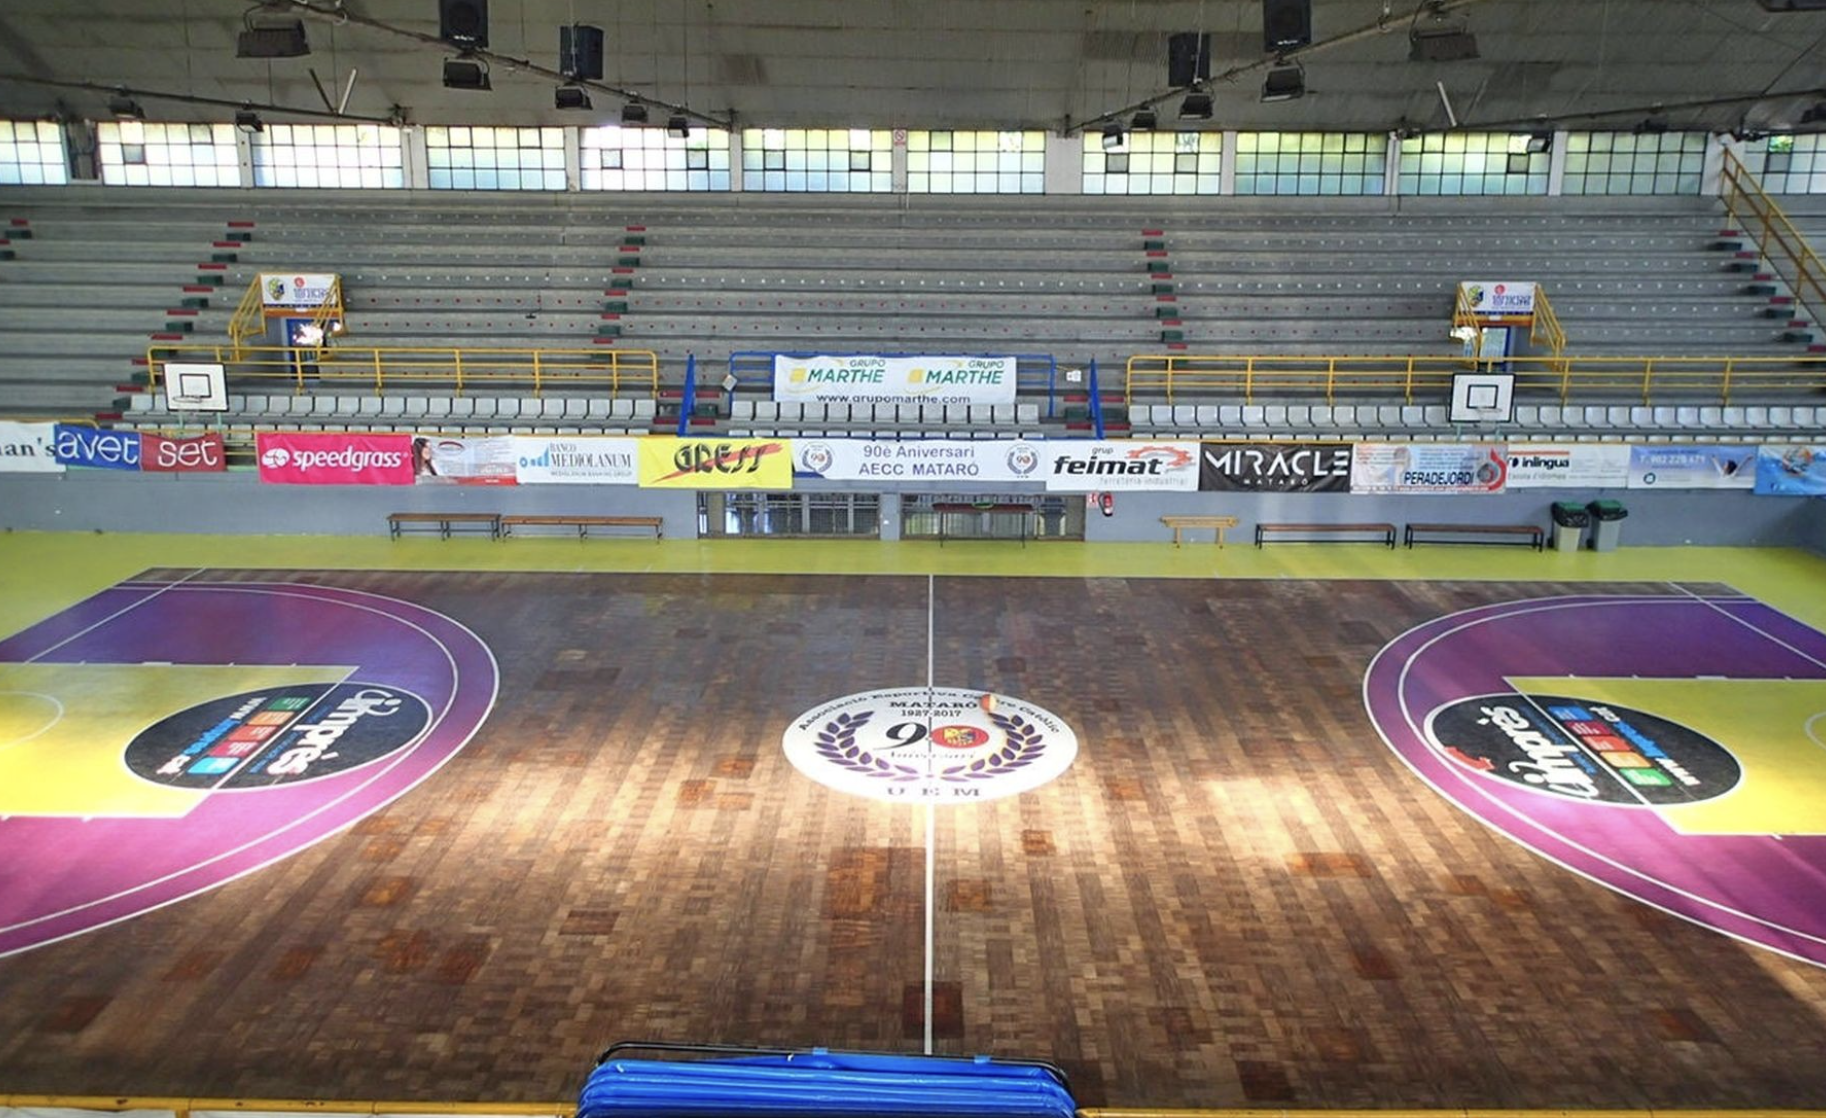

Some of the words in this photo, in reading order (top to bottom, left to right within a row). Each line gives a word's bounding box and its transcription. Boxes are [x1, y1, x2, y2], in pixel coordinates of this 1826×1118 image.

[850, 359, 886, 368] GRUPO
[968, 360, 1004, 369] GRUPO
[807, 369, 886, 383] MARTHE
[925, 370, 1004, 385] MARTHE
[816, 394, 971, 404] www.grupomarthe.com
[0, 437, 56, 457] an's
[58, 431, 140, 464] avet
[157, 439, 218, 467] set
[549, 442, 577, 453] BANCO
[863, 445, 892, 458] 90è
[896, 444, 975, 458] Aniversari
[1092, 447, 1114, 455] grup
[292, 445, 402, 472] speedgrass
[550, 453, 632, 468] MEDIOLANUM
[1053, 455, 1163, 475] feimat
[1205, 450, 1350, 476] MIRACLE
[1522, 456, 1570, 470] inlingua
[858, 463, 904, 475] AECC
[912, 461, 979, 476] MATARÓ
[1404, 471, 1475, 485] PERADEJORDI
[889, 700, 978, 709] MATARÓ
[901, 709, 962, 717] 1927-2017
